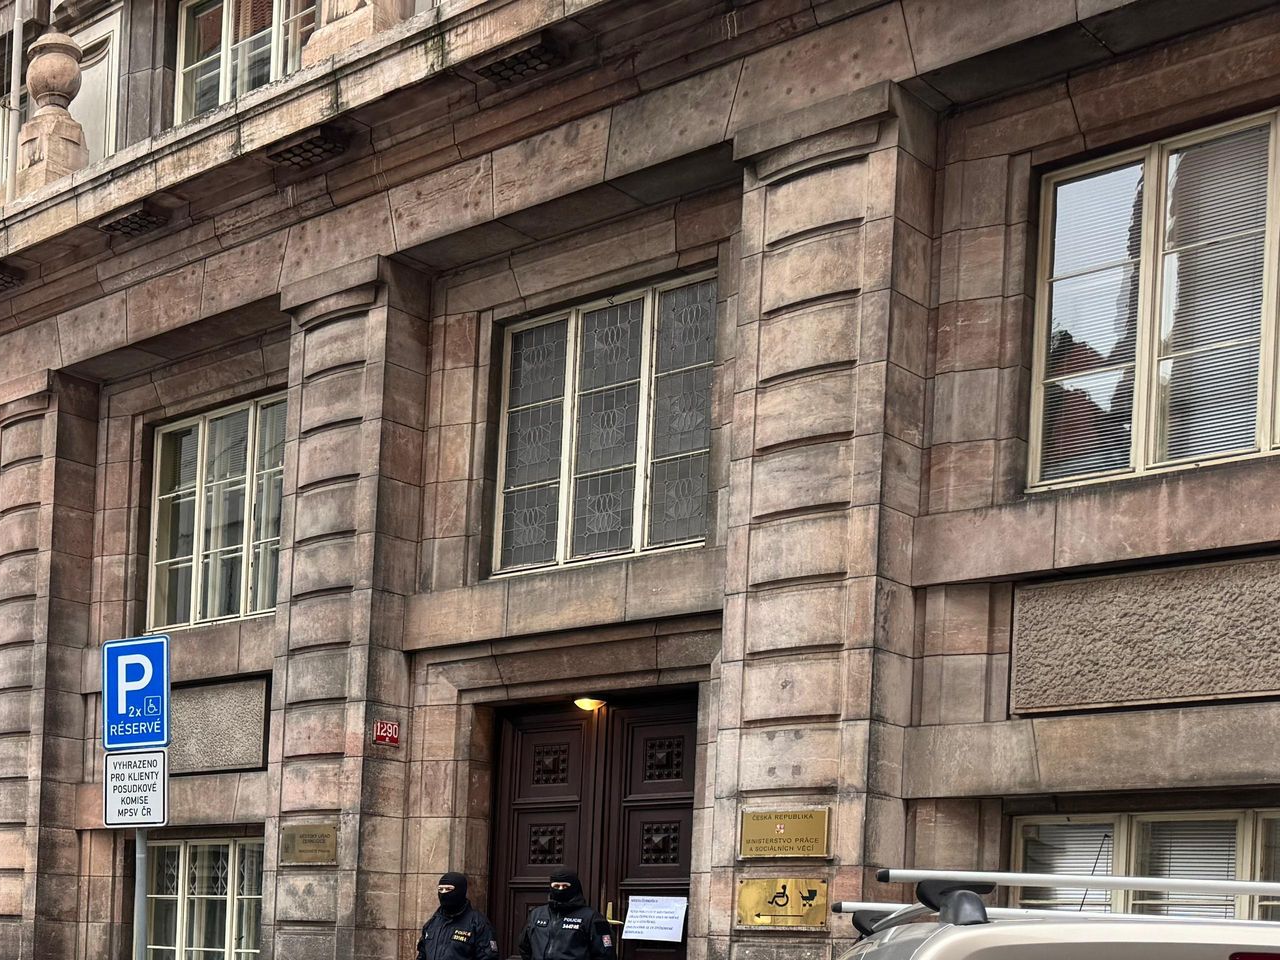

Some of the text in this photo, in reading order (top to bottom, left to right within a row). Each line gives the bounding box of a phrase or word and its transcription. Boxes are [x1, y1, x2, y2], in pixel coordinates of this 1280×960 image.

[117, 653, 153, 715] P
[128, 706, 141, 718] 2x
[110, 718, 161, 736] RÉSERVÉ
[376, 722, 399, 738] 1290
[112, 759, 158, 770] VYHRAZENO
[110, 771, 160, 782] PRO KLIENTY
[112, 783, 157, 794] POSUDKOVÉ
[120, 796, 149, 805] KOMISE
[117, 806, 152, 817] MPSV ČR
